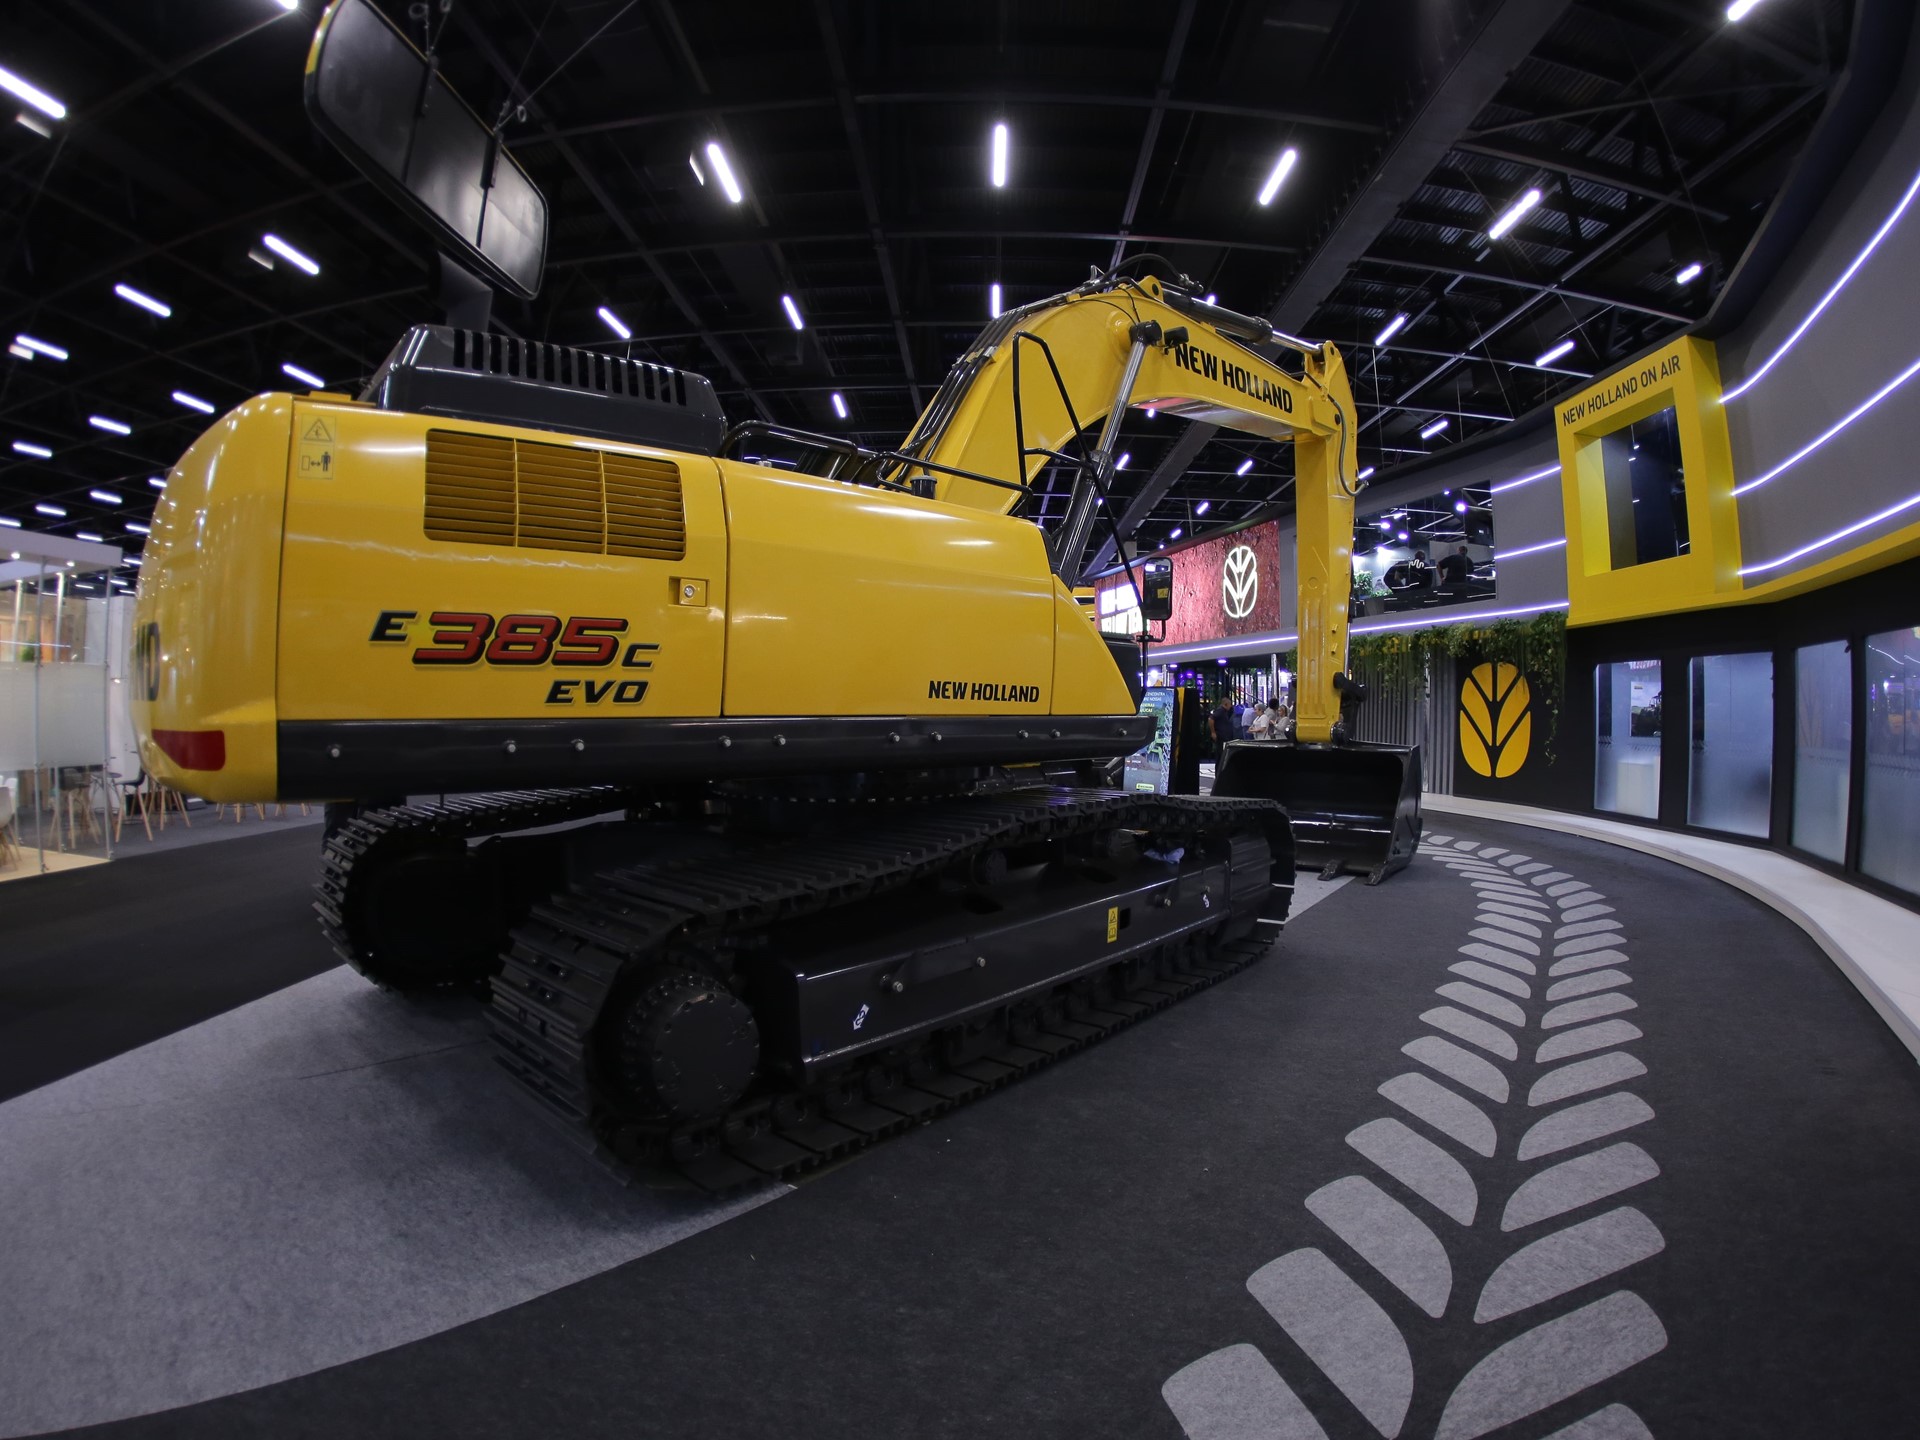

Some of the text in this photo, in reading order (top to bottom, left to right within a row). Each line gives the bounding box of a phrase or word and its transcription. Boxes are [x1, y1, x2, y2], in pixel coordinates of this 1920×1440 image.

[1174, 342, 1293, 414] NEW HOLLAND
[1563, 355, 1681, 426] NEW HOLLAND ON AIR
[544, 680, 650, 704] EVO
[928, 680, 1040, 703] NEW HOLLAND
